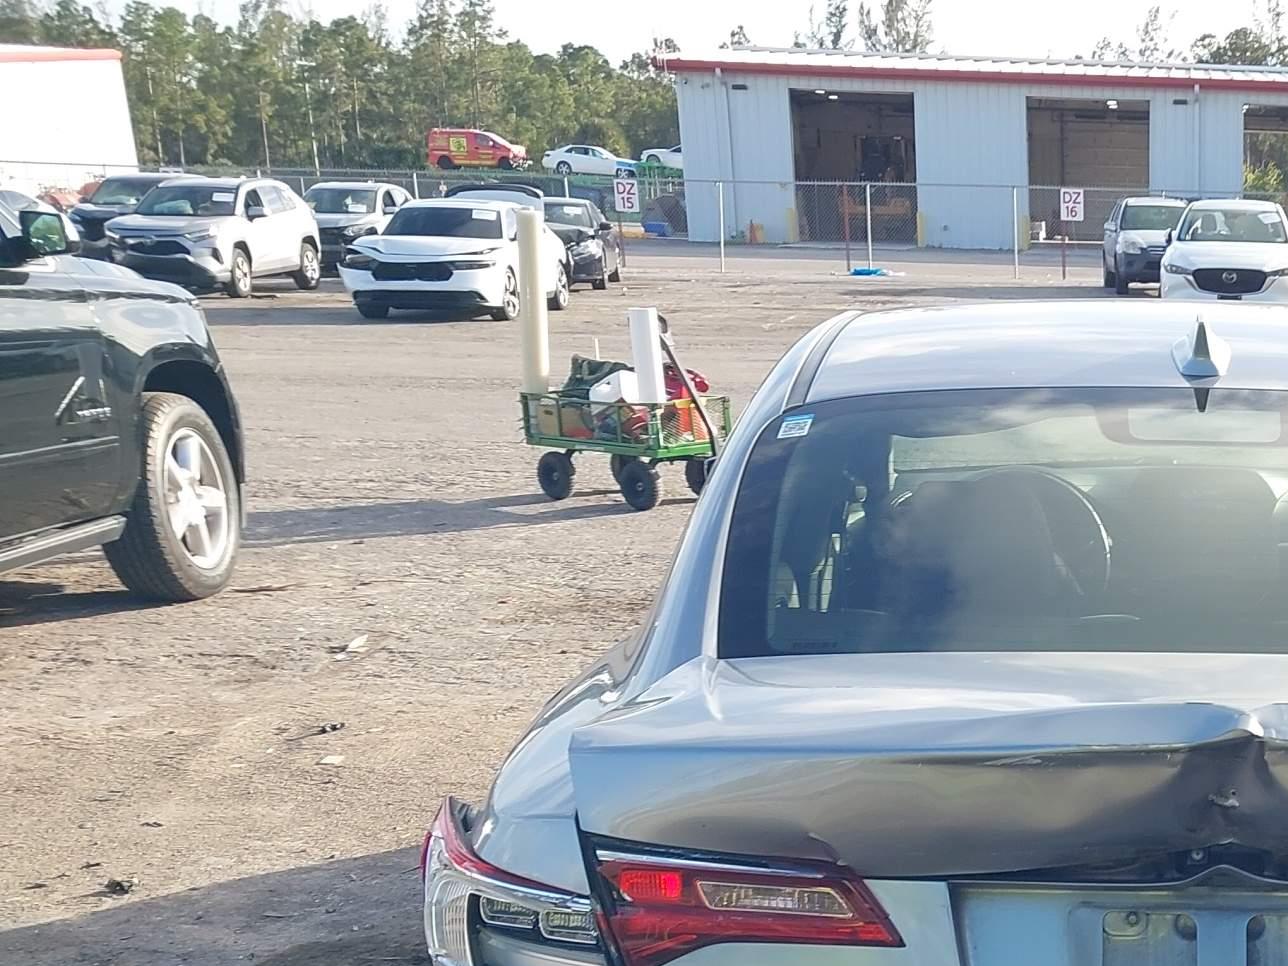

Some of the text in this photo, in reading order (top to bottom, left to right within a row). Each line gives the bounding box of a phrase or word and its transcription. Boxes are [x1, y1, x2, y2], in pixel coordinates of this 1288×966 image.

[616, 181, 636, 195] DZ
[621, 196, 634, 209] 15
[1063, 191, 1081, 204] DZ
[1066, 206, 1077, 218] 16
